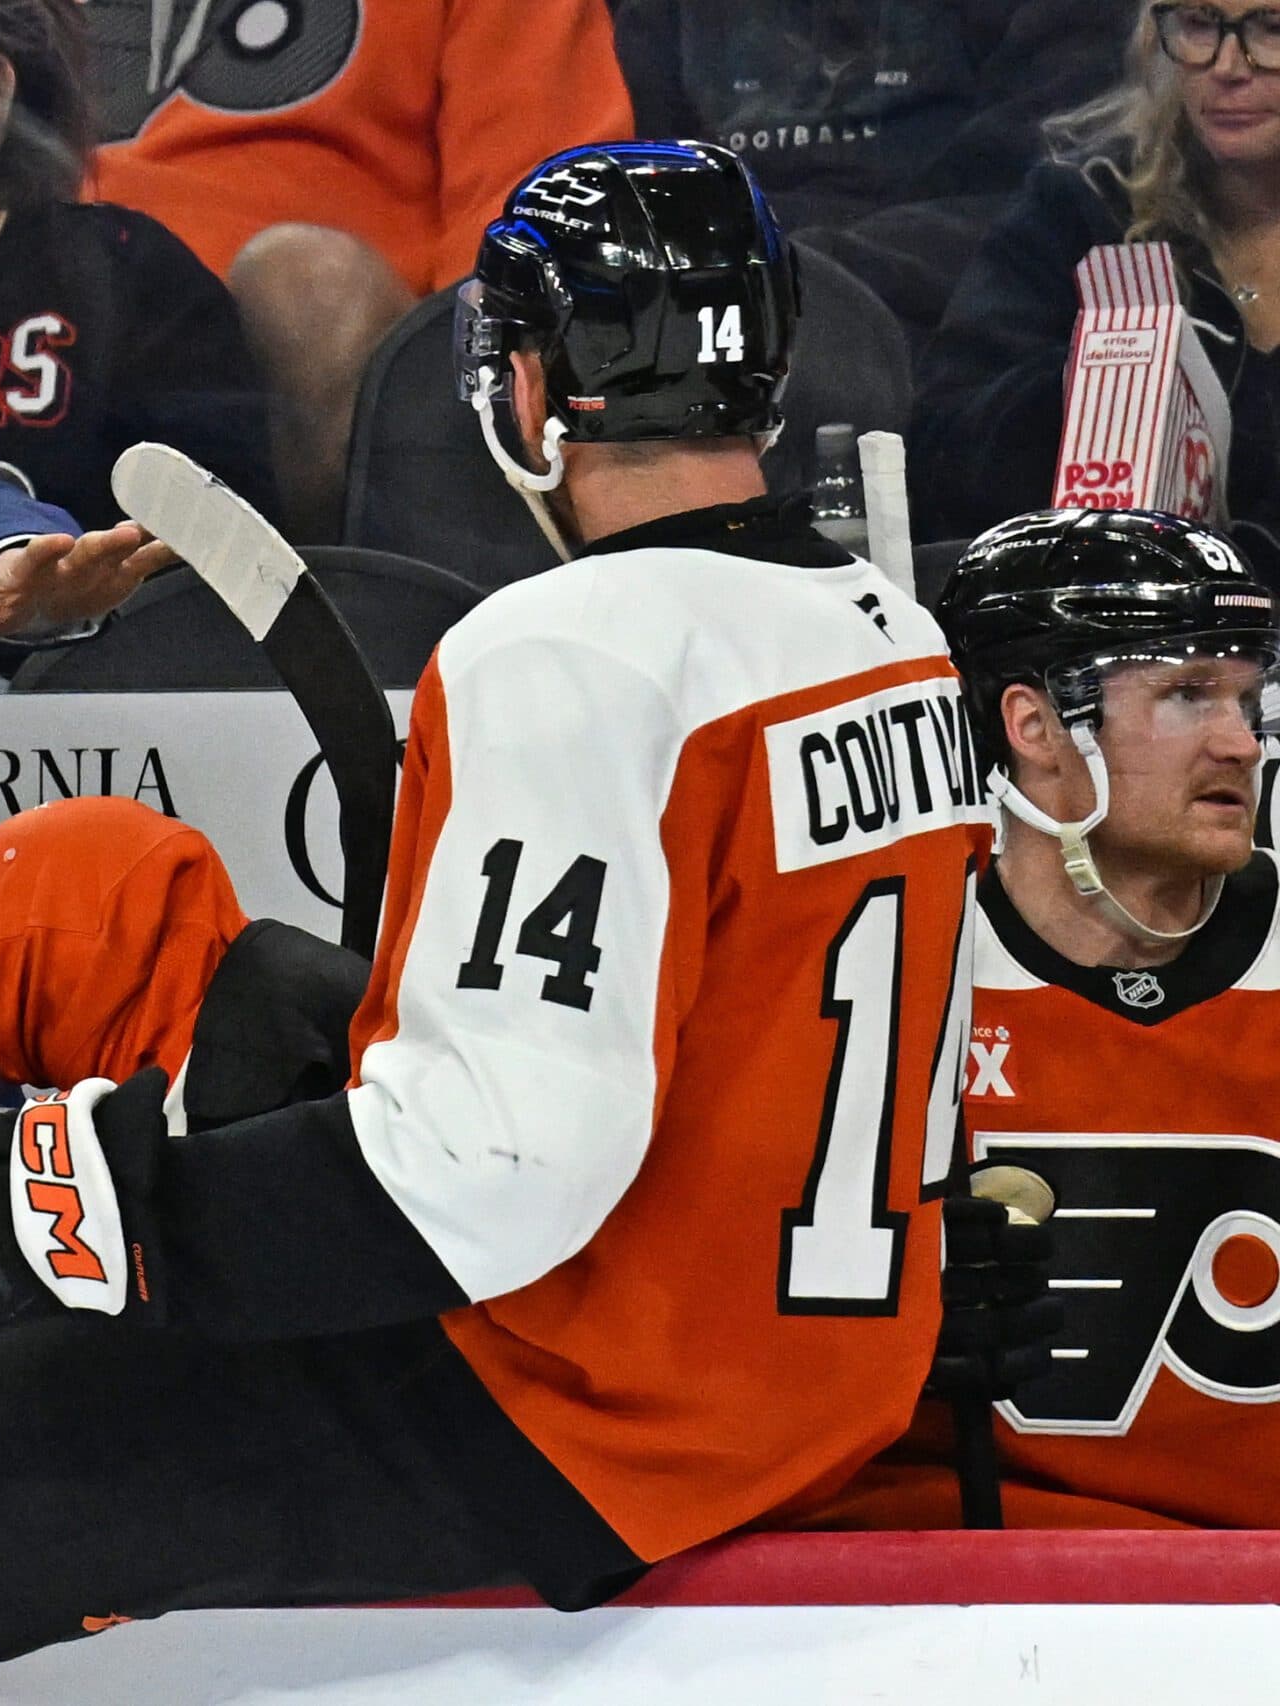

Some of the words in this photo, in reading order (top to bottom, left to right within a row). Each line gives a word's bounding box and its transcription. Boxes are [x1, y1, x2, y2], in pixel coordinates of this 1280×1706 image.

[512, 206, 593, 231] CHEVROLET
[697, 304, 744, 363] 14
[1103, 336, 1137, 347] crisp
[1086, 348, 1150, 360] delicious
[1065, 461, 1133, 491] POP
[456, 838, 607, 1013] 14
[20, 1090, 109, 1284] CM
